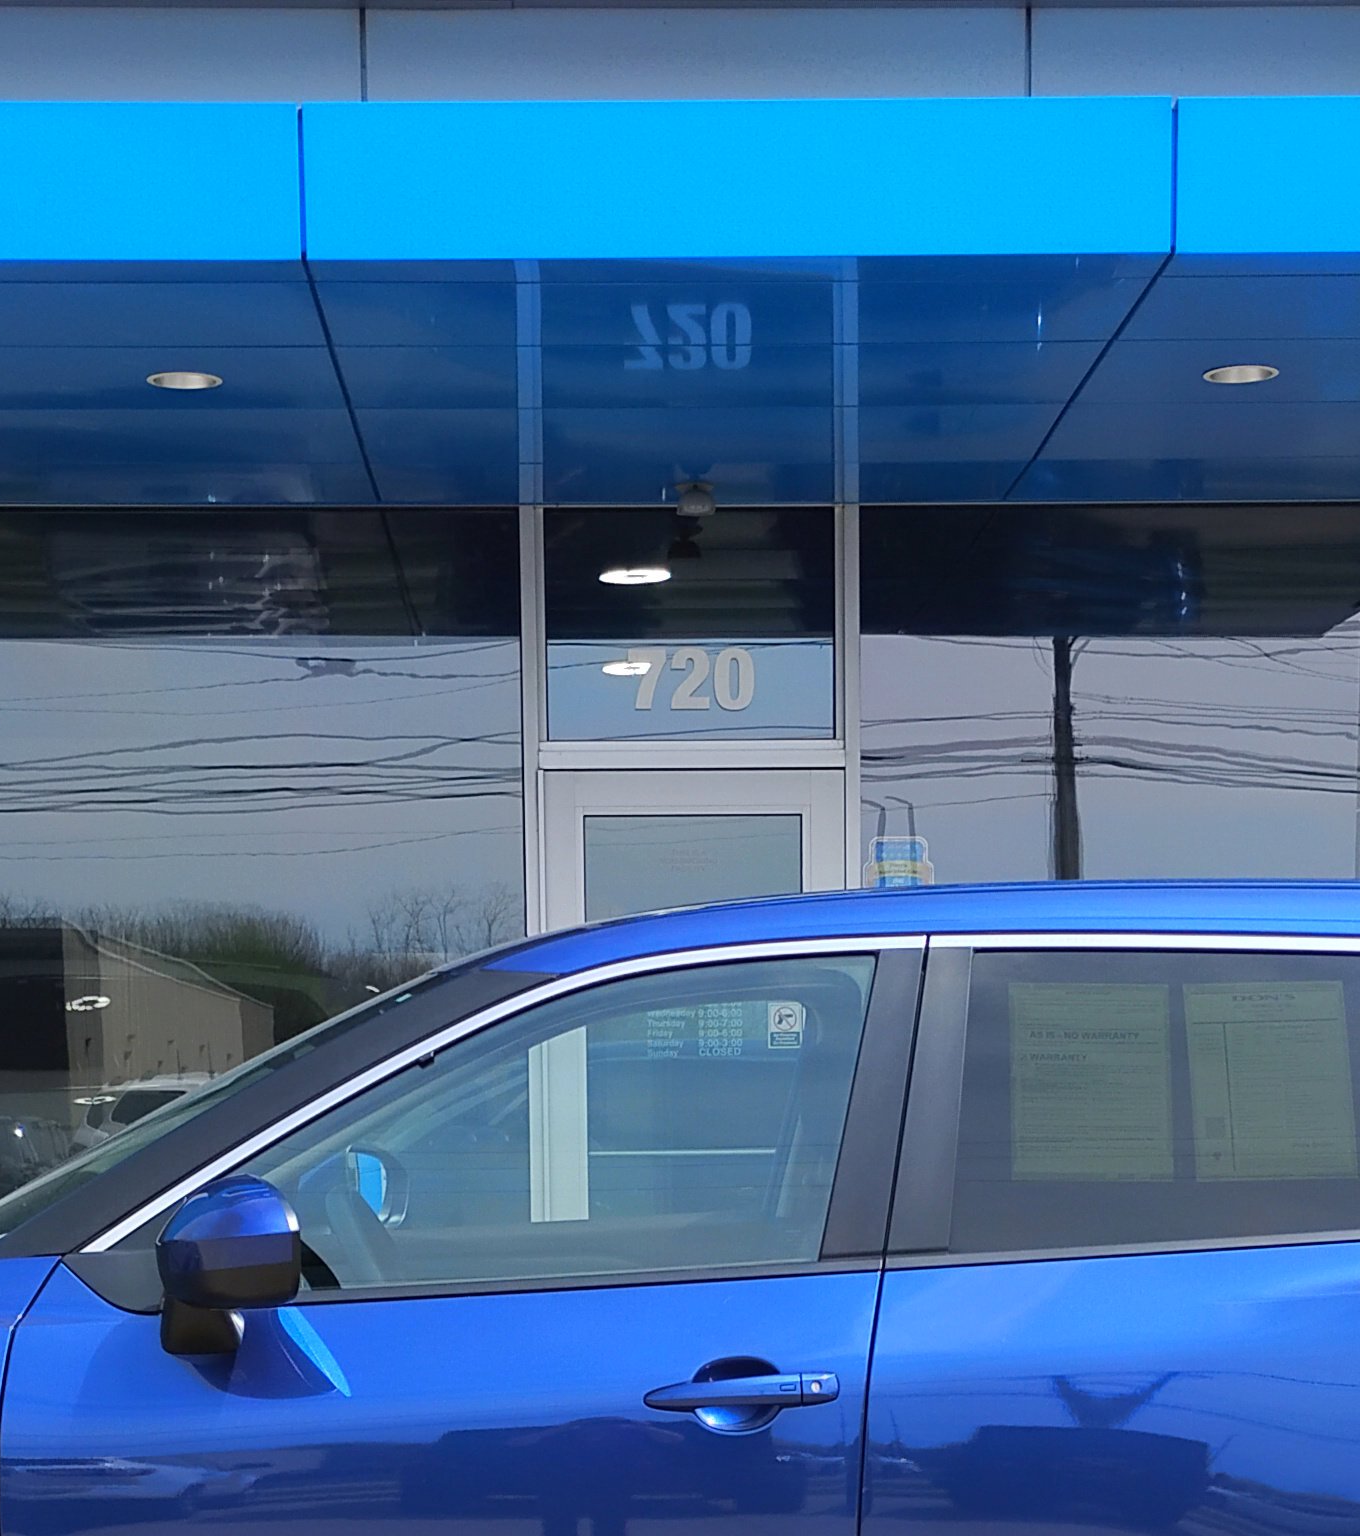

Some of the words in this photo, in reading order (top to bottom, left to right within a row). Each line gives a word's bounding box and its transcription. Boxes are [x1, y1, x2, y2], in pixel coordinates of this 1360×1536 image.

[628, 647, 755, 711] 720
[1232, 993, 1296, 1002] DON'S
[647, 1010, 696, 1018] Wednesday
[647, 1019, 685, 1029] Thursday
[647, 1029, 673, 1039] Friday
[1029, 1031, 1044, 1040] AS
[1046, 1031, 1056, 1040] IS
[1064, 1031, 1079, 1040] NO
[1081, 1031, 1140, 1040] WARRANTY
[647, 1039, 684, 1048] Saturday
[647, 1048, 679, 1058] Sunday
[698, 1047, 742, 1056] CLOSED
[1029, 1053, 1088, 1062] WARRANTY
